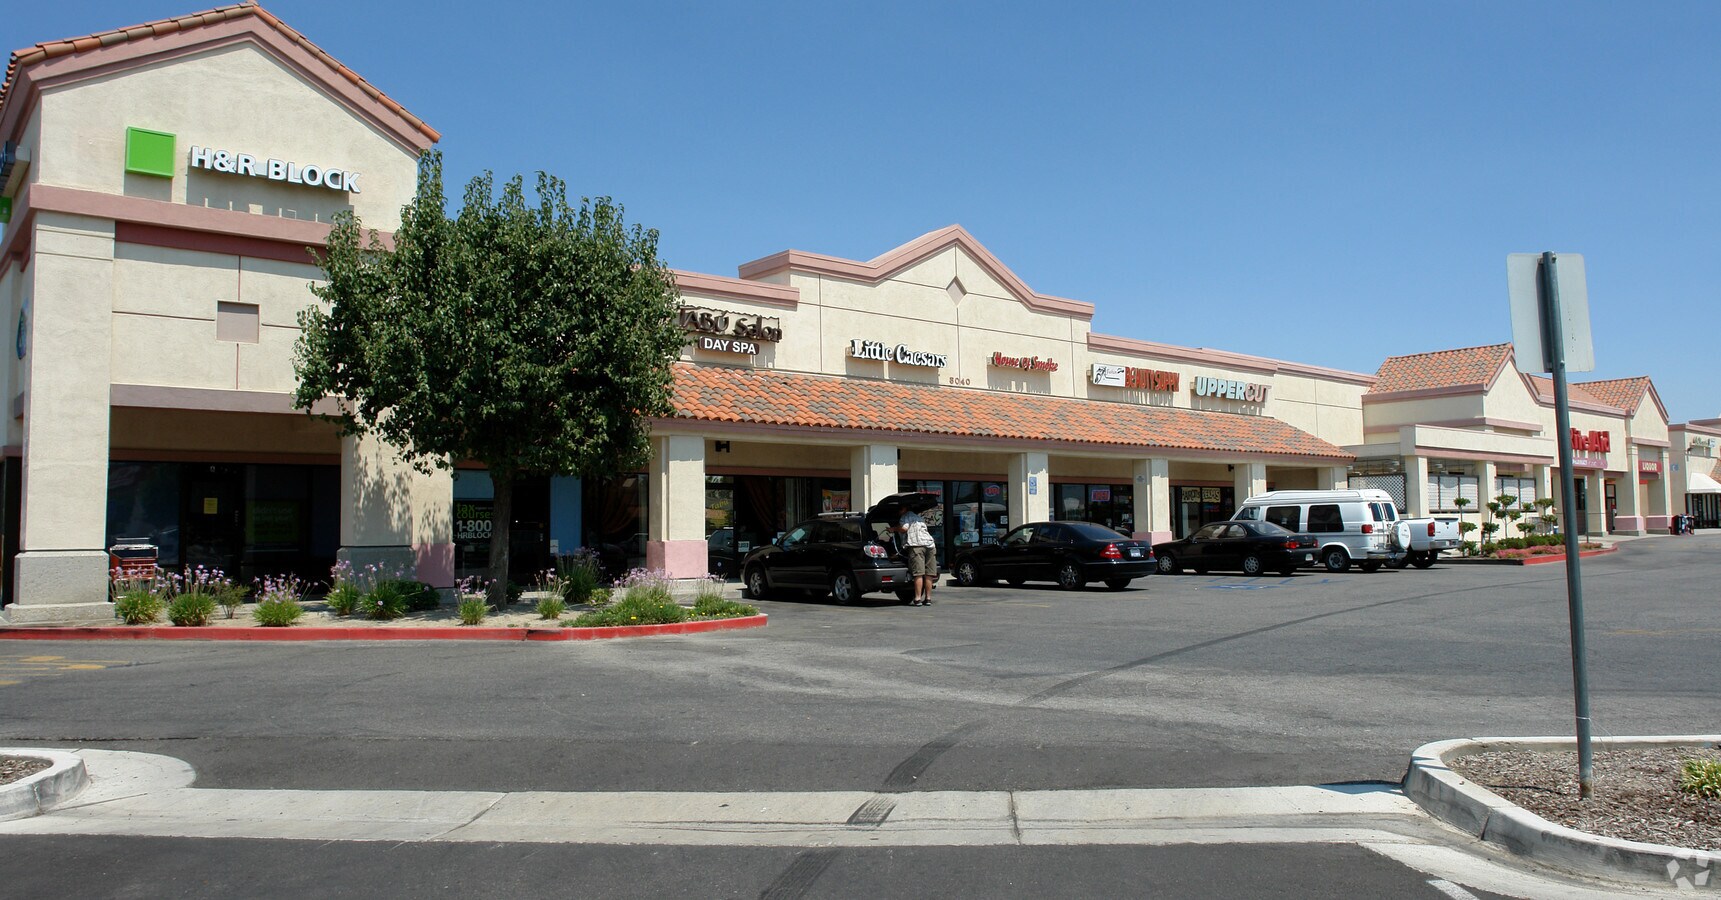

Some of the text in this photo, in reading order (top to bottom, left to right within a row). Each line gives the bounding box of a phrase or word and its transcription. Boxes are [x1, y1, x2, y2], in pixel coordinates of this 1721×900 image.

[191, 145, 361, 193] H&R BLOCK
[733, 315, 782, 343] Salon
[704, 338, 756, 354] DAY SPA
[851, 339, 947, 368] Little Caesars
[994, 352, 1019, 368] House
[1032, 356, 1058, 372] Smoke
[949, 376, 971, 385] 8040
[1125, 366, 1180, 392] BEAUTY SUPPLY
[1195, 376, 1272, 403] UPPERCUT
[1590, 431, 1610, 452] Aid
[1642, 462, 1657, 471] LIQUOR
[456, 503, 476, 511] tax
[456, 520, 492, 532] 1-800
